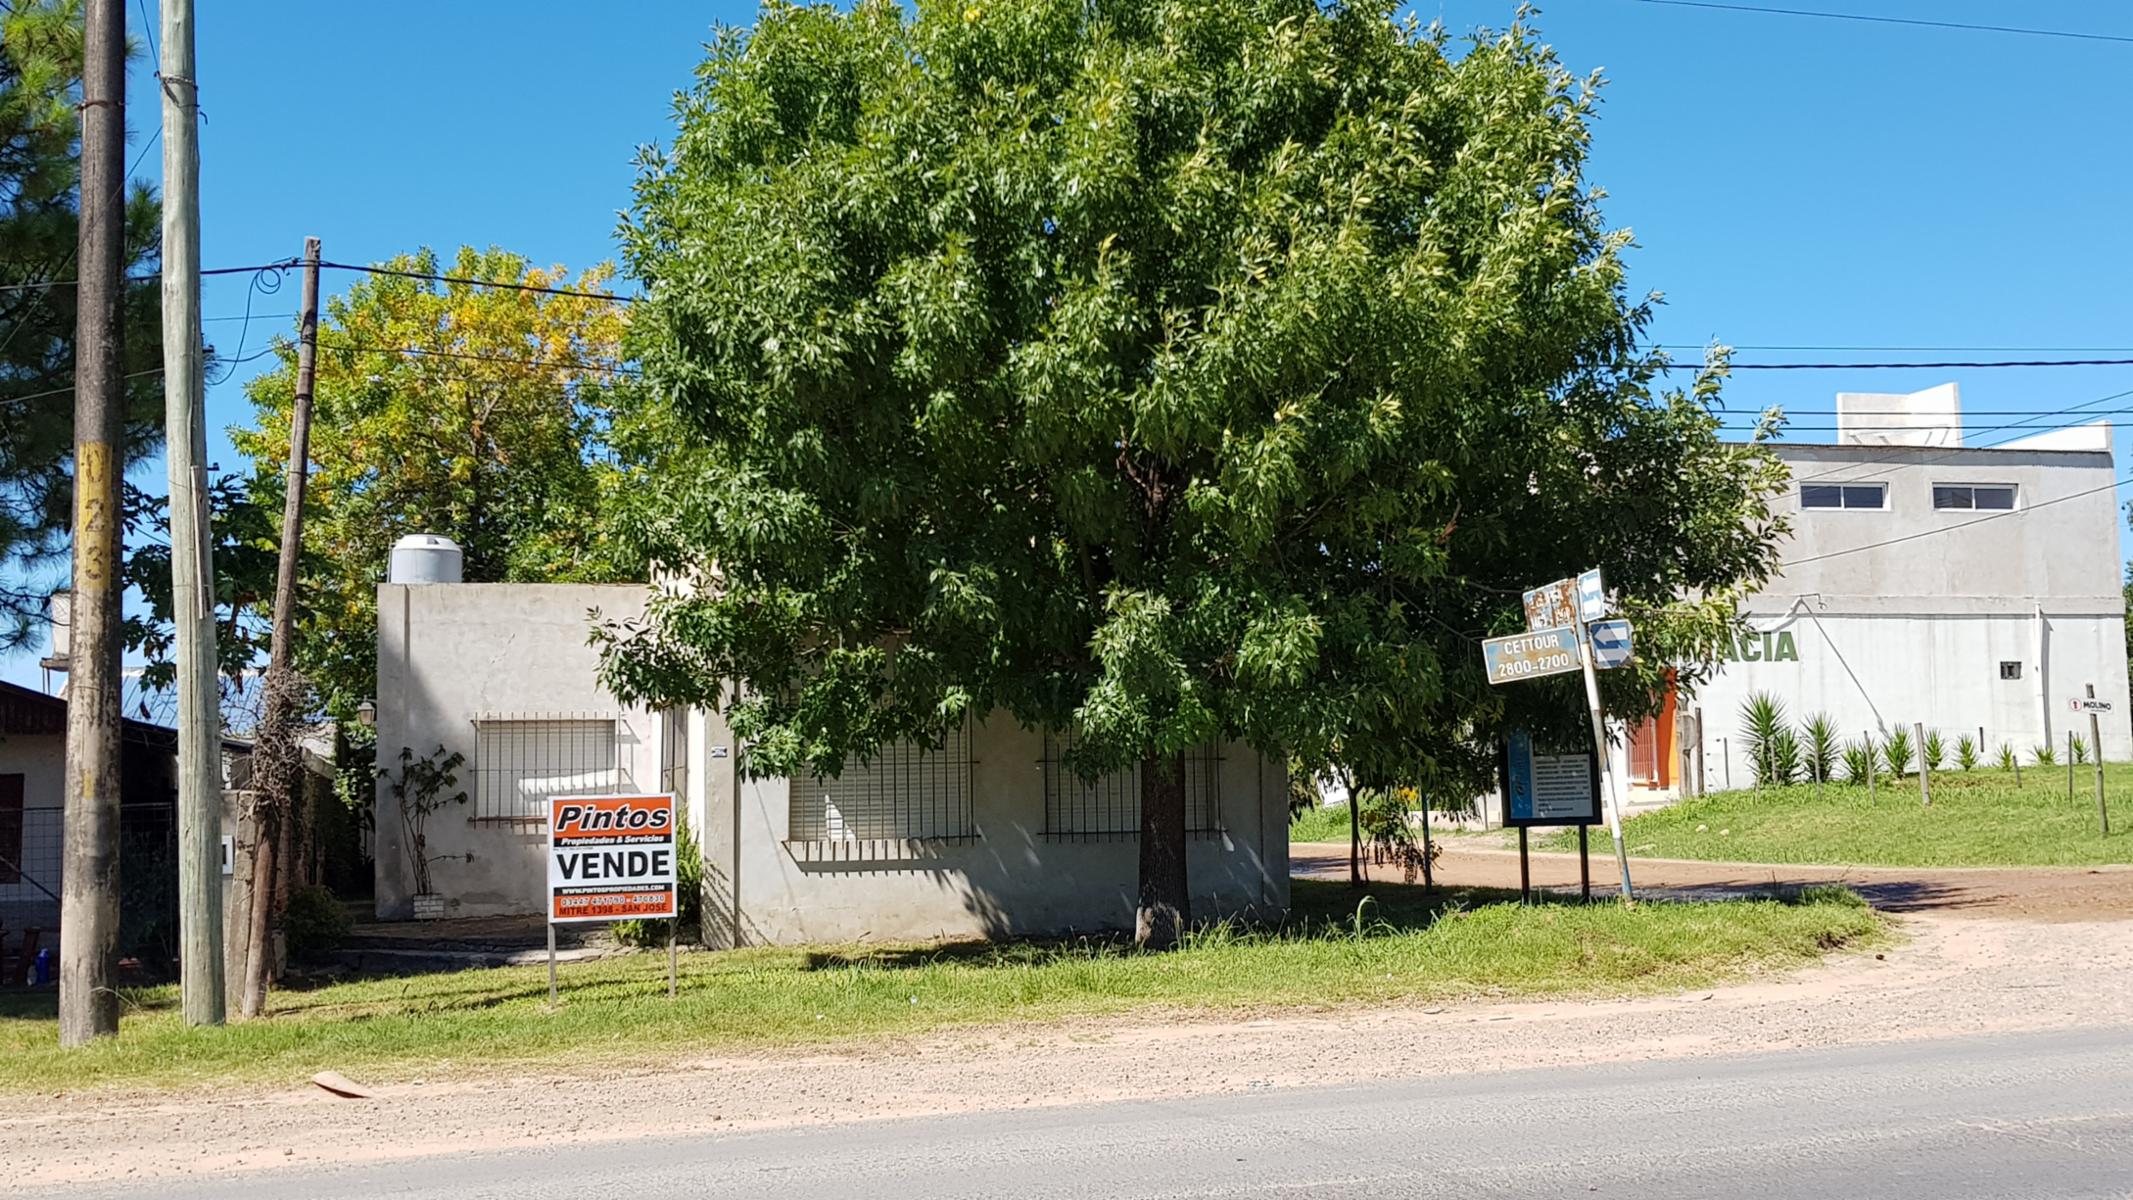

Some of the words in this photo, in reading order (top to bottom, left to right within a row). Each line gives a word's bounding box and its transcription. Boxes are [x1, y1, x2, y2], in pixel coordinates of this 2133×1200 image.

[1504, 634, 1559, 655] CETTOUR
[1498, 653, 1569, 677] 2800-2700
[2083, 701, 2112, 710] MOLINO
[556, 804, 671, 831] Pintos
[561, 836, 615, 846] Propiedades
[624, 835, 665, 843] Servicios
[556, 850, 670, 879] VENDE
[559, 907, 588, 915] MITRE
[622, 904, 640, 913] SAN
